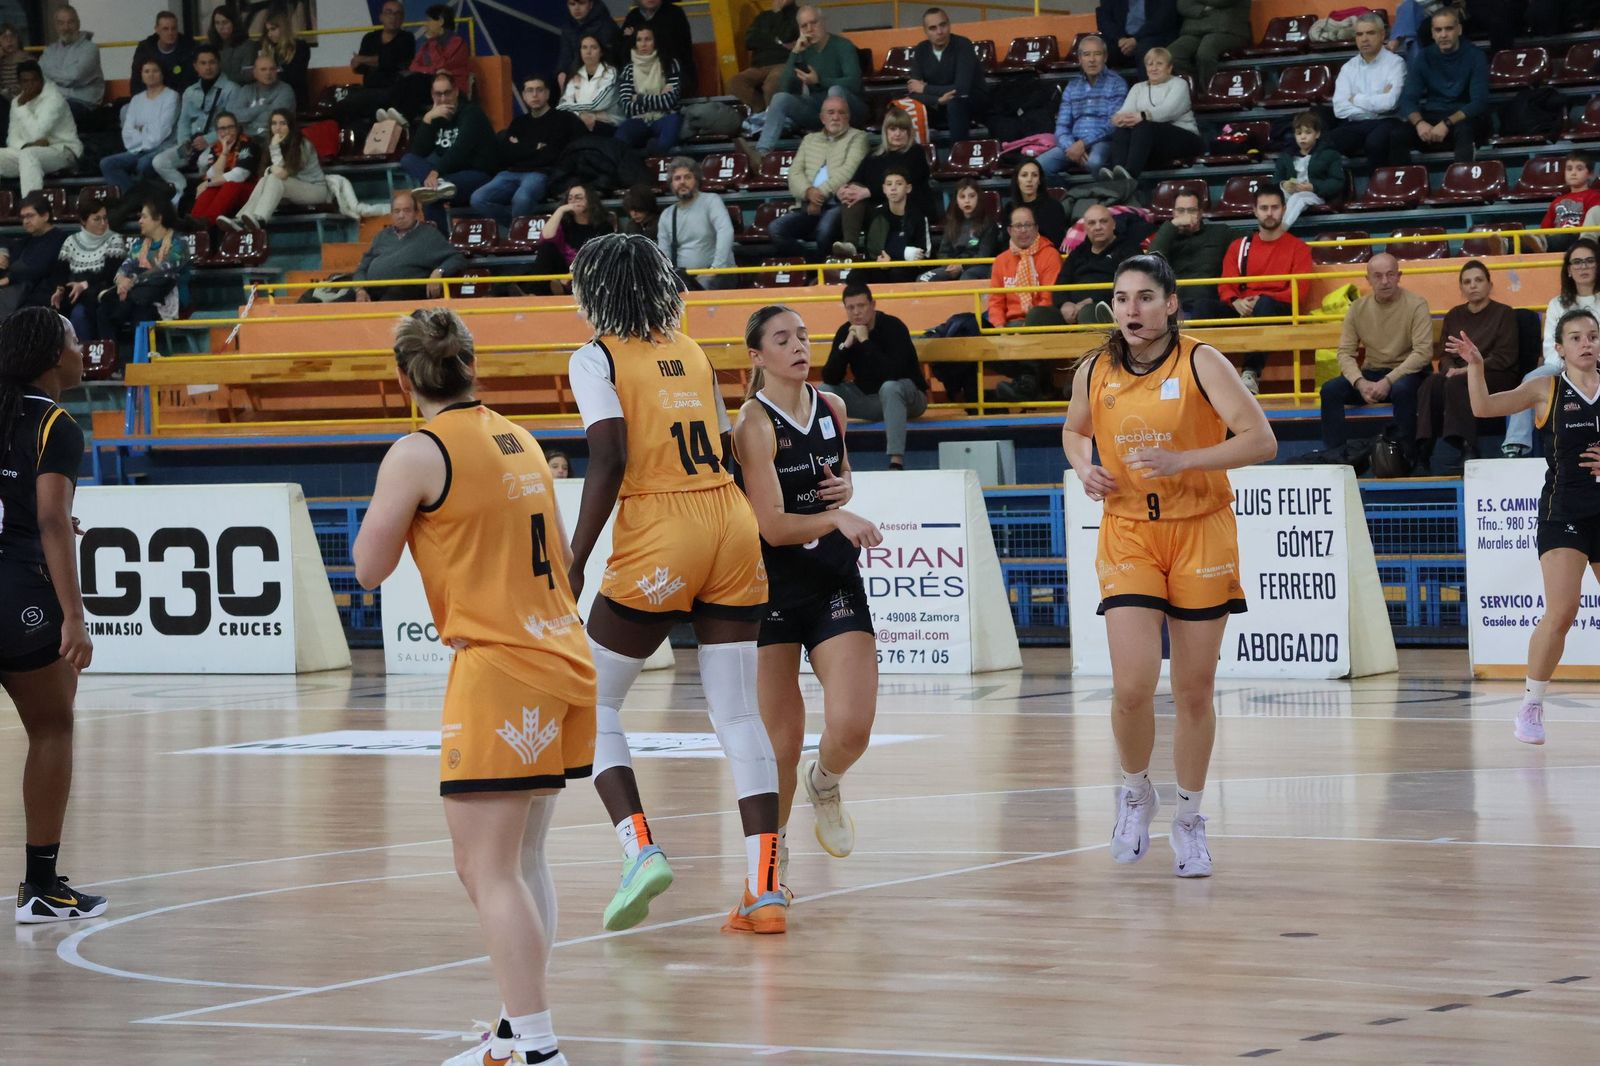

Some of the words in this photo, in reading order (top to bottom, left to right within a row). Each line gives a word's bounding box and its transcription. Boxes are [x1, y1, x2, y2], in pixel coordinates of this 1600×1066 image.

[1289, 20, 1298, 32] 2
[1026, 42, 1040, 51] 10
[1516, 54, 1526, 66] 7
[1232, 76, 1242, 88] 2
[1304, 69, 1310, 82] 1
[972, 144, 982, 156] 8
[720, 156, 734, 168] 16
[1544, 161, 1559, 174] 11
[1394, 170, 1405, 185] 7
[1471, 166, 1482, 178] 9
[470, 224, 482, 233] 22
[528, 219, 545, 232] 20
[657, 360, 686, 376] FILOR
[1114, 430, 1172, 444] recoletas
[670, 421, 720, 475] 14
[1146, 493, 1160, 520] 9
[1236, 488, 1272, 516] LUIS
[1278, 488, 1332, 515] FELIPE
[1477, 498, 1496, 512] E.S.
[1500, 498, 1539, 512] CAMIN
[1477, 516, 1503, 531] Tfno.:
[1506, 517, 1524, 530] 980
[1277, 526, 1334, 558] GÓMEZ
[1478, 536, 1513, 550] Morales
[1516, 534, 1530, 550] del
[530, 513, 554, 590] 4
[80, 526, 281, 635] G3C
[1260, 572, 1336, 600] FERRERO
[1480, 595, 1532, 608] SERVICIO
[1536, 595, 1544, 608] A
[886, 612, 917, 622] 49008
[920, 613, 960, 622] Zamora
[1482, 616, 1516, 626] Gasóleo
[1520, 616, 1530, 626] de
[218, 622, 282, 636] CRUCES
[1237, 633, 1338, 662] ABOGADO
[888, 650, 905, 664] 76
[910, 650, 926, 663] 71
[932, 650, 950, 664] 05
